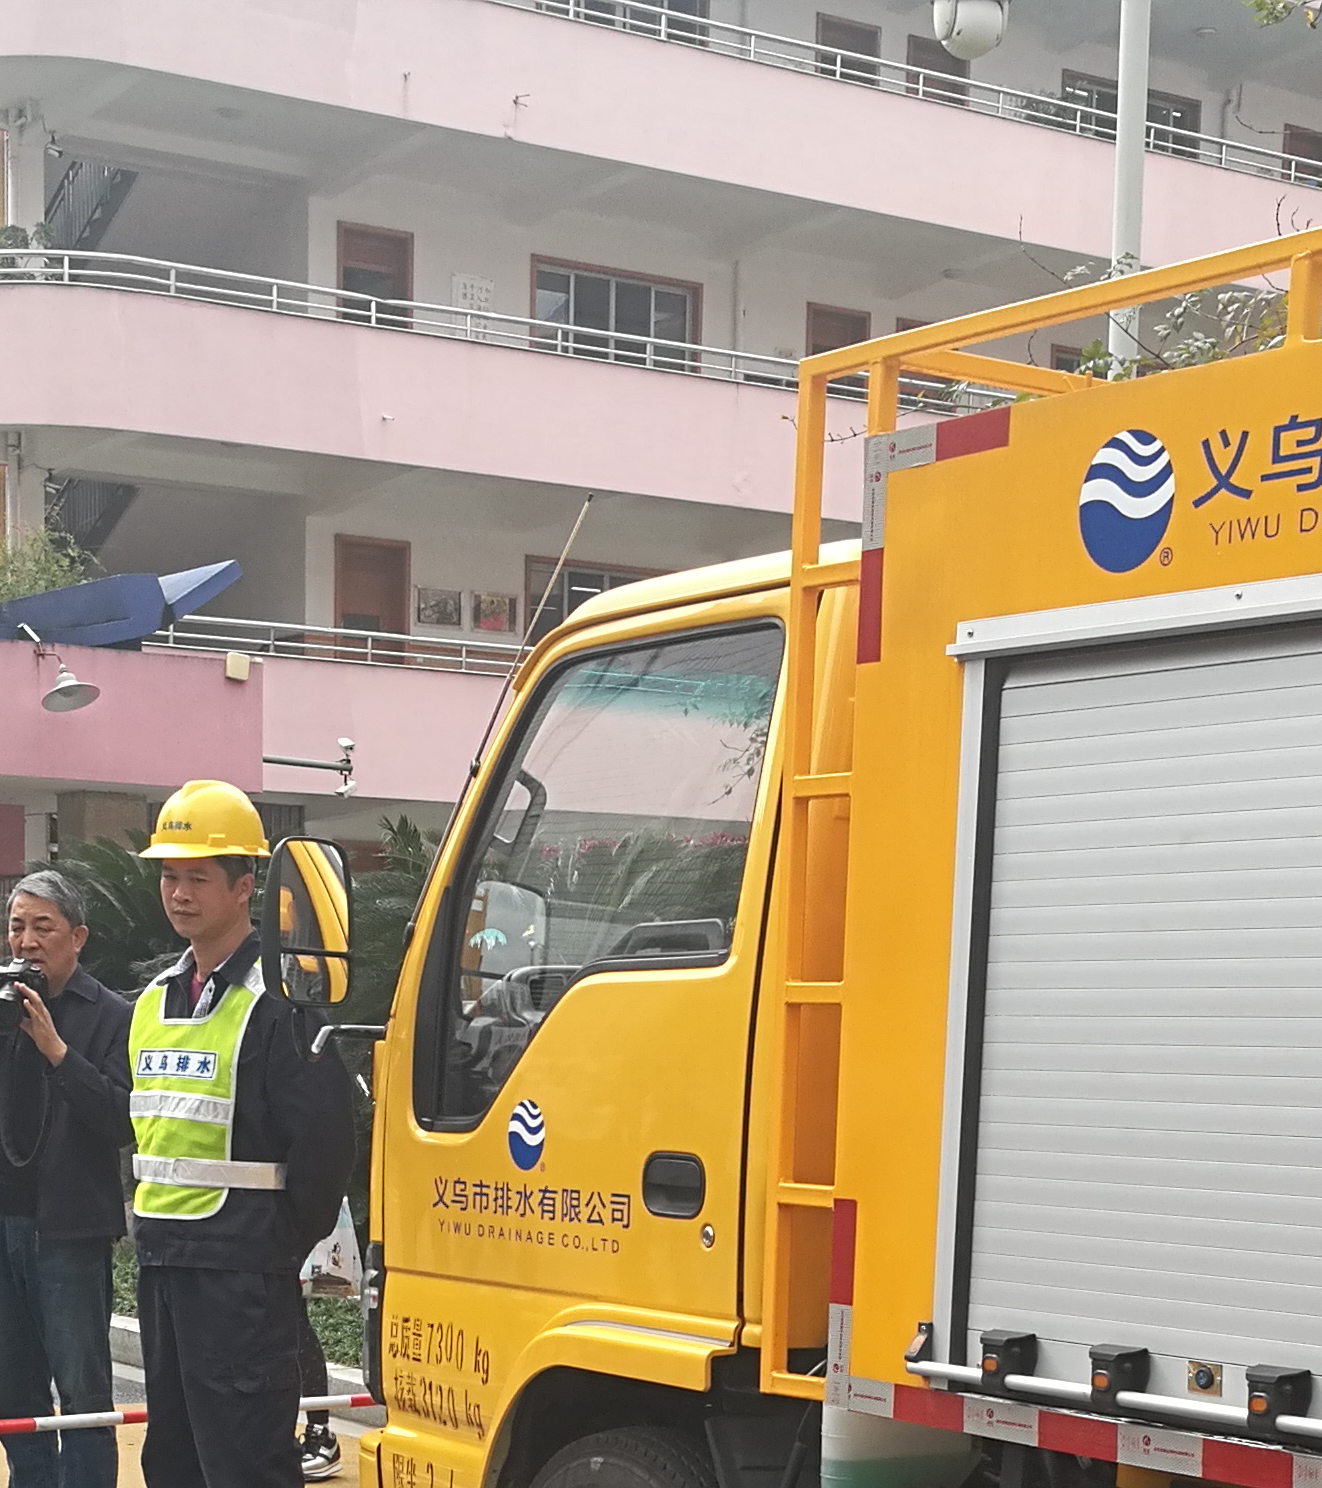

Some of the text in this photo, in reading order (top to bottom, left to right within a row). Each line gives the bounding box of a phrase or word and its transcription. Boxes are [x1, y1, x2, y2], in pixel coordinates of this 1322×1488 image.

[1209, 514, 1281, 546] YIWU
[142, 1054, 211, 1074] 义乌排水
[432, 1175, 632, 1230] 义乌市排水有限公司
[438, 1218, 472, 1236] YIWU
[477, 1223, 556, 1246] DRAINAGE
